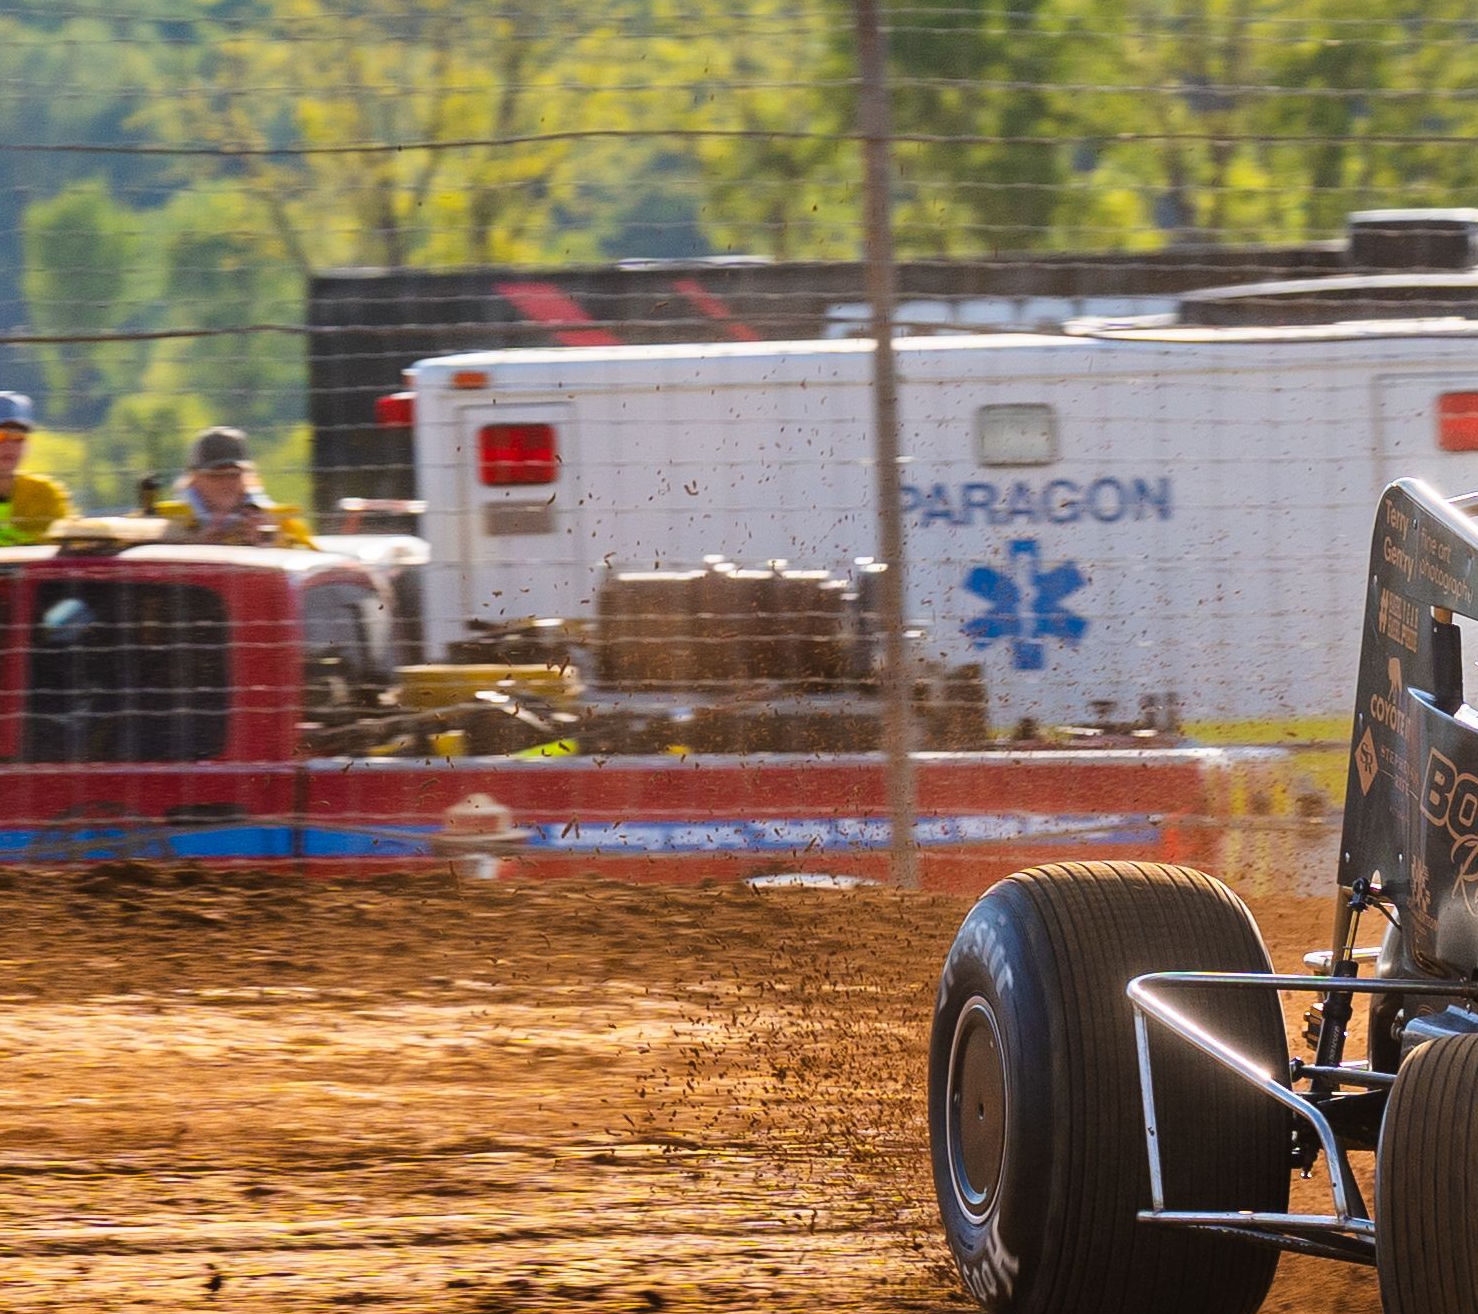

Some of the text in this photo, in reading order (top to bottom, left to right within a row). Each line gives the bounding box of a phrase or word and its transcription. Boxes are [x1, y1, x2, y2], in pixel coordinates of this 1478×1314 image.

[900, 477, 1172, 527] PARAGON
[1385, 498, 1410, 541] Terry
[1383, 536, 1415, 582] Gentry
